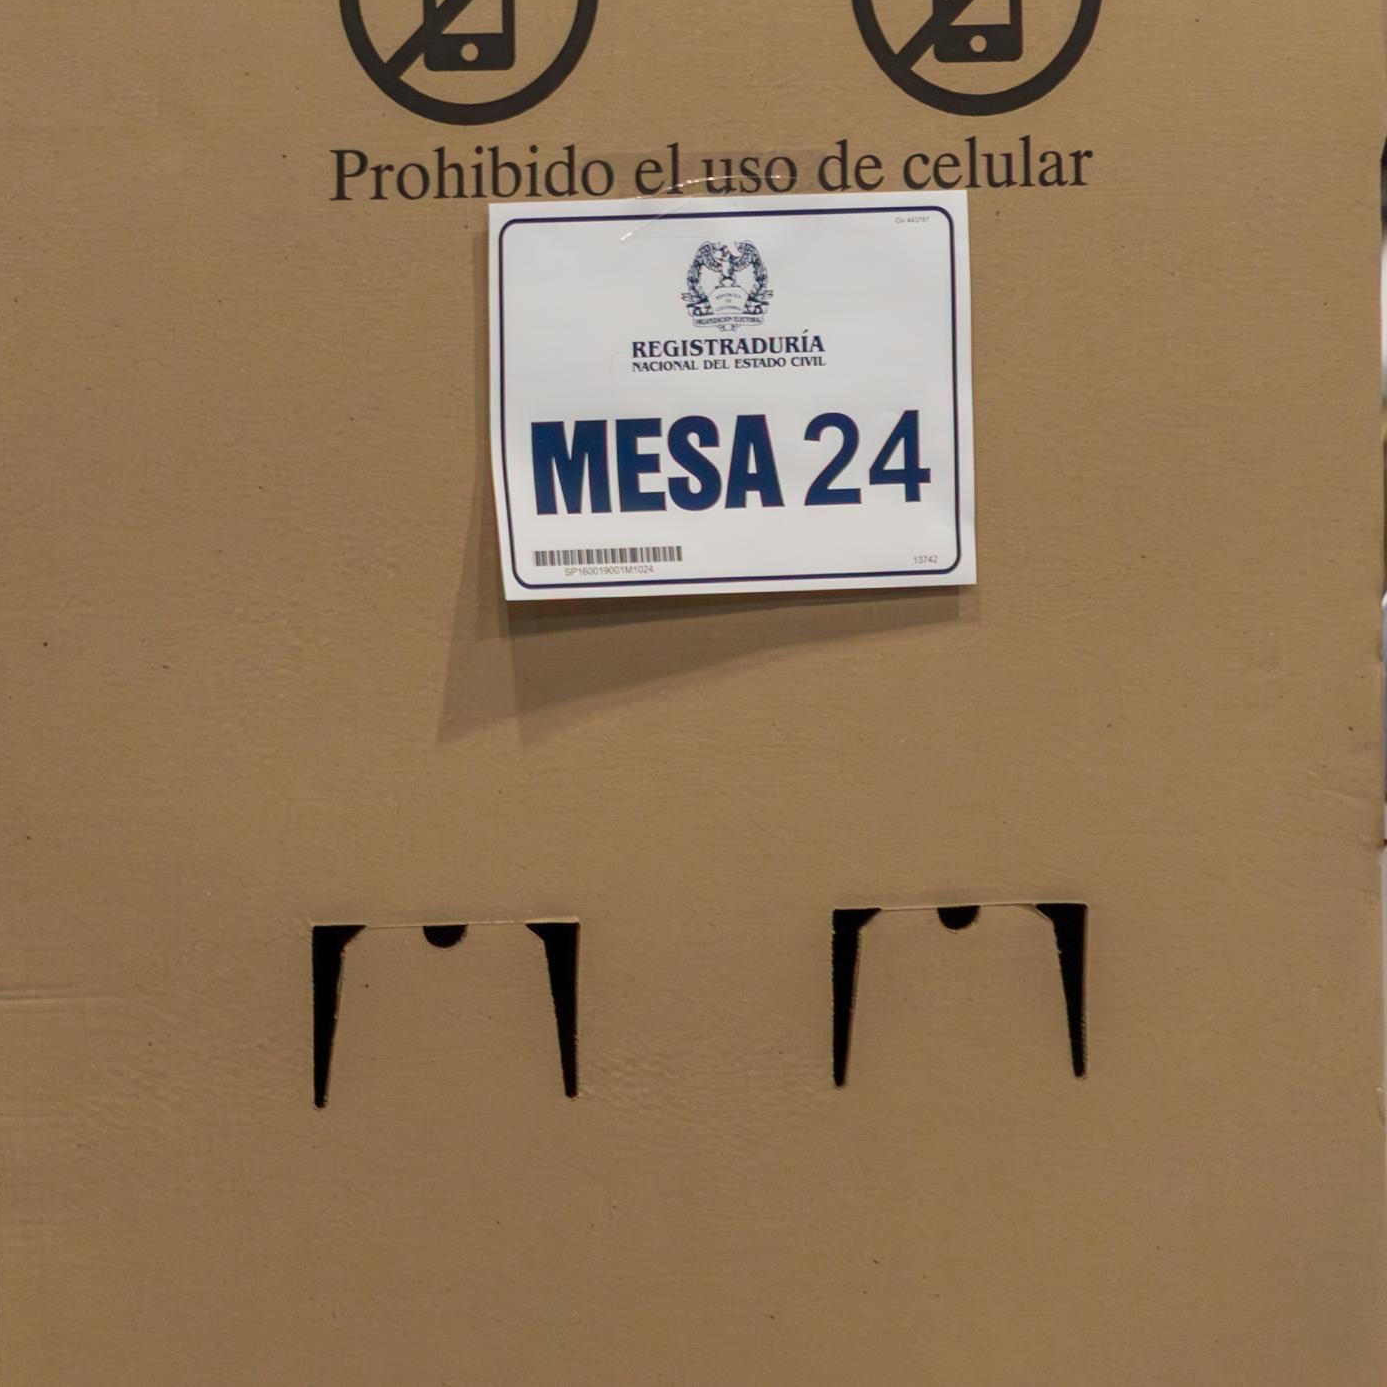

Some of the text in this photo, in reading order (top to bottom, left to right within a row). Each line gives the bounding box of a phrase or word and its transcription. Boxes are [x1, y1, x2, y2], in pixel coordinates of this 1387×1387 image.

[329, 135, 1094, 201] Prohibido el uso de celular
[632, 329, 826, 358] REGISTRADURÍA
[632, 356, 826, 373] NACIONAL DEL ESTADO CIVIL
[530, 409, 931, 516] MESA 24
